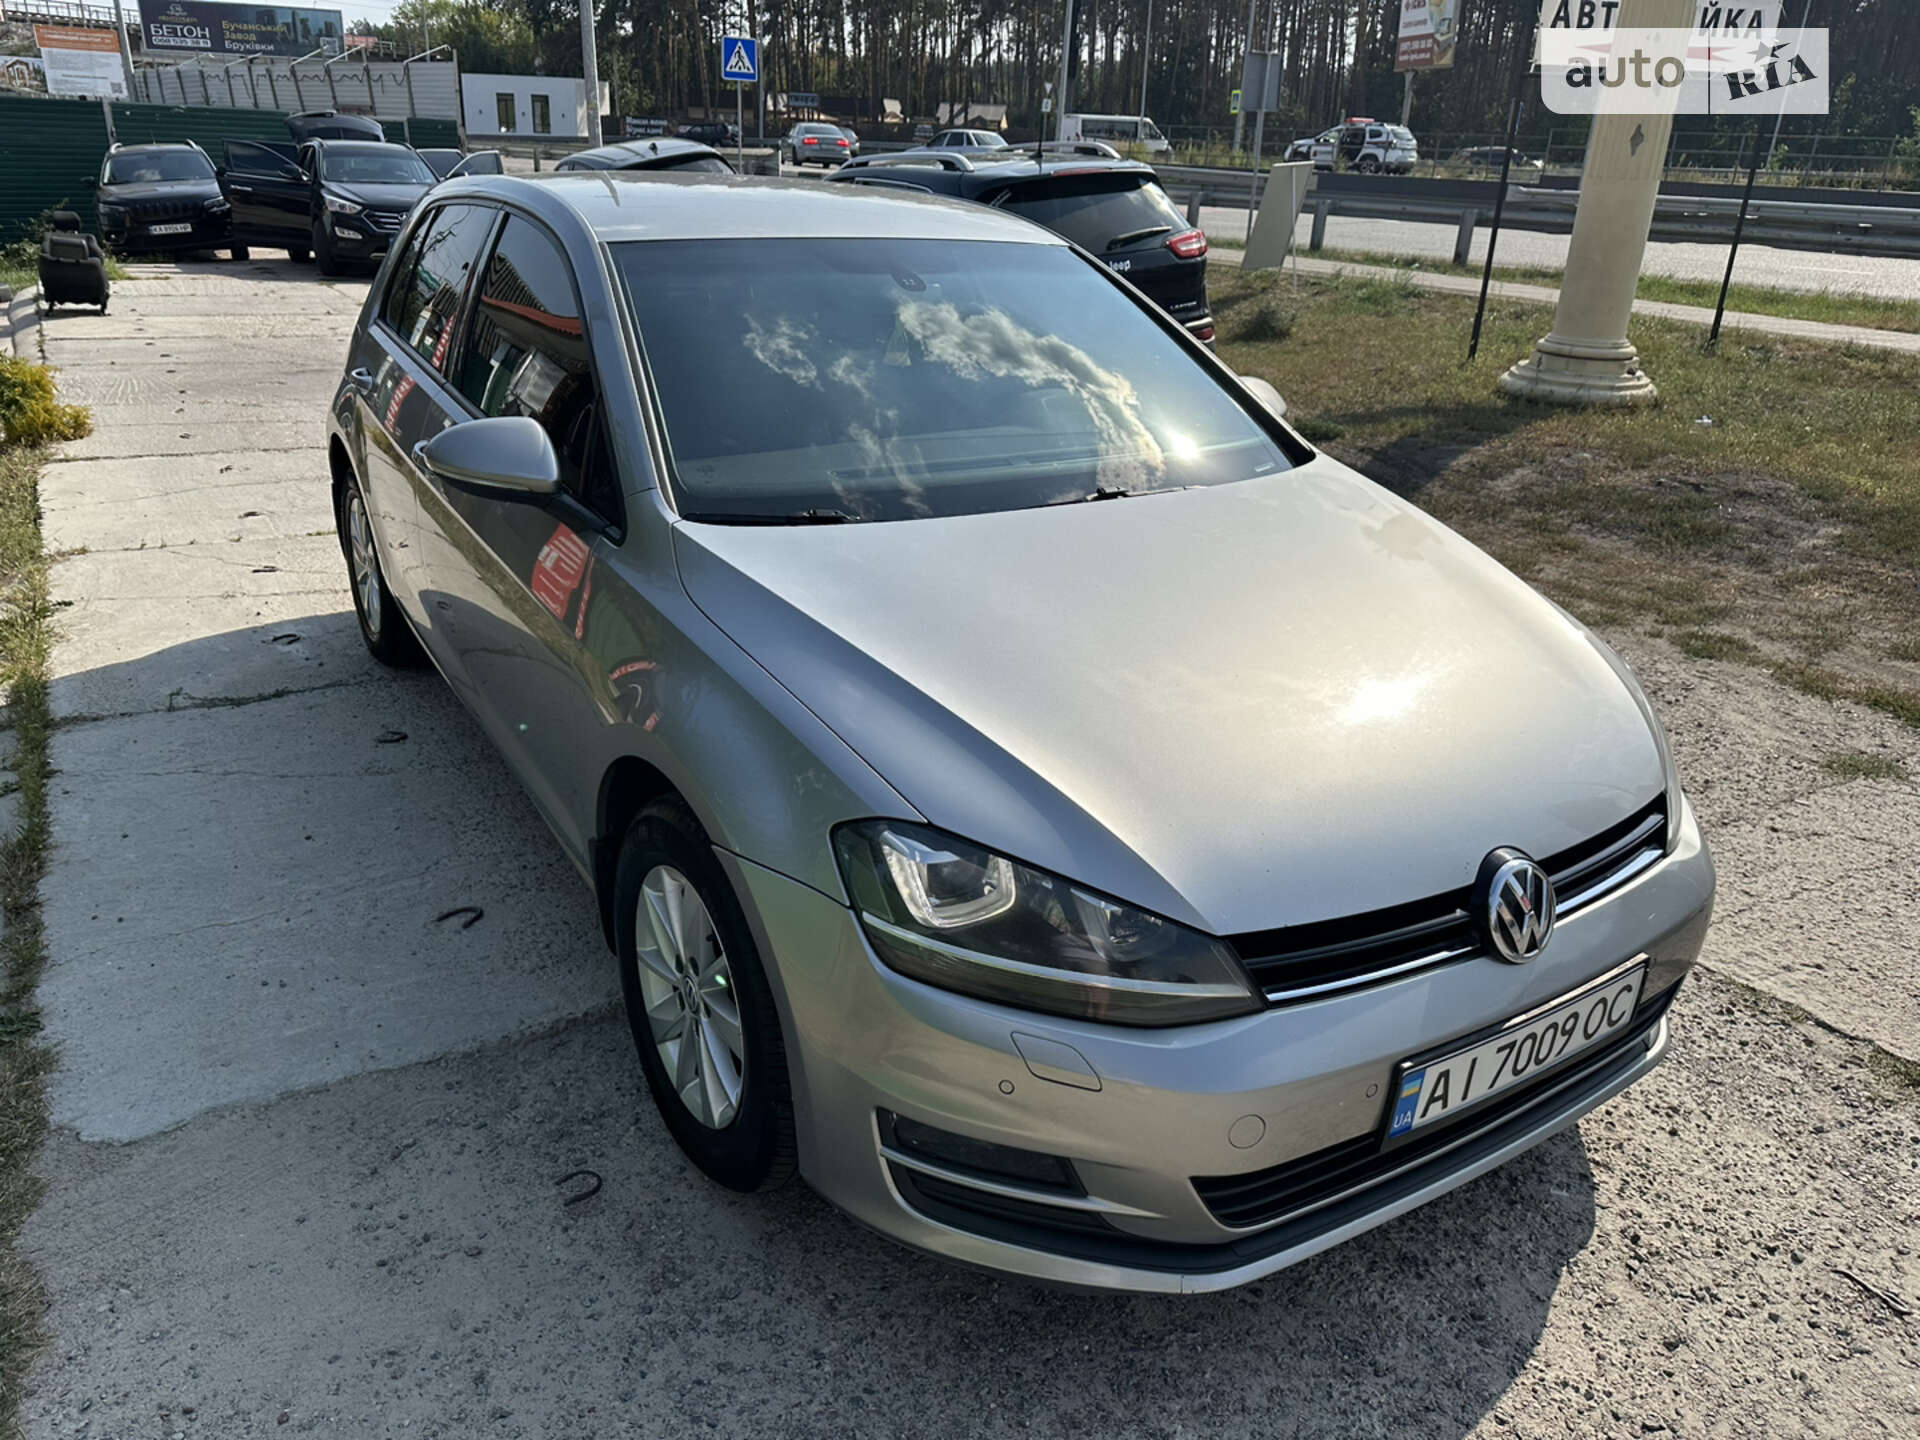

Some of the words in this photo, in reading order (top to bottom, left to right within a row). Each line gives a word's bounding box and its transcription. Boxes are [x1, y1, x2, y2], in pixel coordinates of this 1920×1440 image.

[1550, 0, 1764, 40] АВТЙКА
[150, 23, 210, 38] БЕТОН
[224, 31, 257, 40] Завод
[224, 41, 275, 51] Бруківки
[1419, 1058, 1478, 1118] AI
[1488, 1012, 1579, 1089] 7009
[1583, 985, 1632, 1040] OC
[1393, 1112, 1412, 1128] UA
